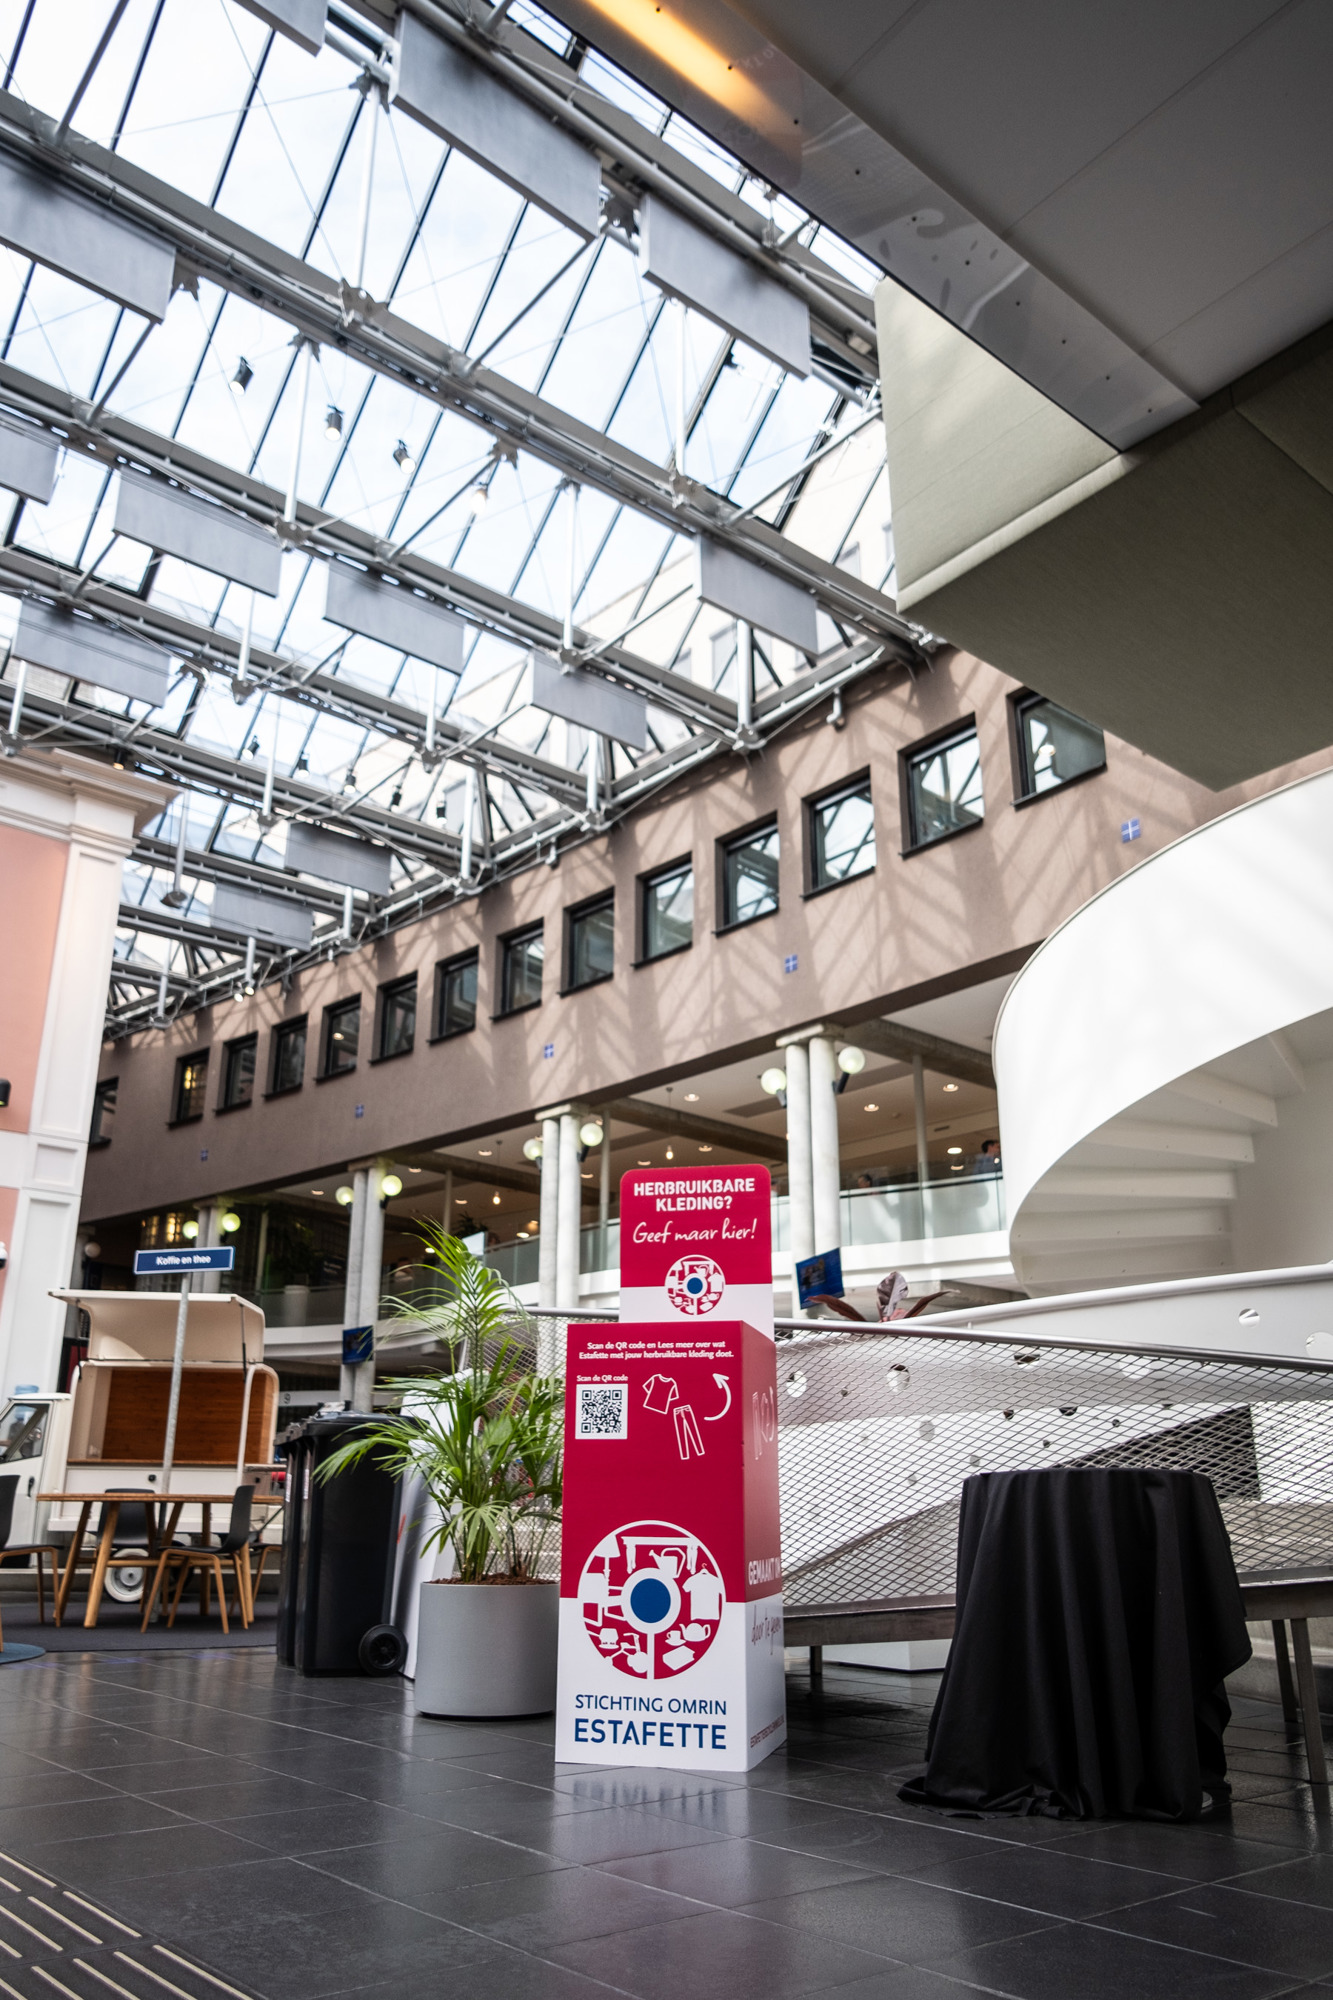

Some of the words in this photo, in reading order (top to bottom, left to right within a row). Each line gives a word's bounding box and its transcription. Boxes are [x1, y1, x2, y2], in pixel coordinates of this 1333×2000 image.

[633, 1178, 755, 1196] HERBRUIKBARE
[656, 1196, 732, 1212] KLEDING?
[632, 1221, 673, 1244] Geef
[674, 1229, 718, 1241] maar
[721, 1217, 757, 1240] hier!
[155, 1256, 180, 1265] Koffie
[181, 1256, 192, 1264] en
[193, 1255, 211, 1263] thee
[587, 1342, 603, 1350] Scan
[605, 1342, 614, 1350] de
[615, 1341, 627, 1350] QR
[628, 1341, 646, 1349] code
[657, 1340, 674, 1349] Lees
[712, 1340, 726, 1348] wat
[579, 1351, 608, 1360] Estafette
[610, 1351, 624, 1359] met
[624, 1351, 642, 1360] jouw
[643, 1350, 687, 1359] herbruikbare
[688, 1350, 714, 1359] kleding
[715, 1349, 734, 1358] doet.
[576, 1374, 591, 1382] Scan
[592, 1374, 600, 1382] de
[601, 1374, 612, 1382] QR
[613, 1373, 628, 1381] code
[575, 1694, 663, 1712] STICHTING
[668, 1698, 727, 1715] OMRIN
[574, 1718, 727, 1750] ESTAFETTE
